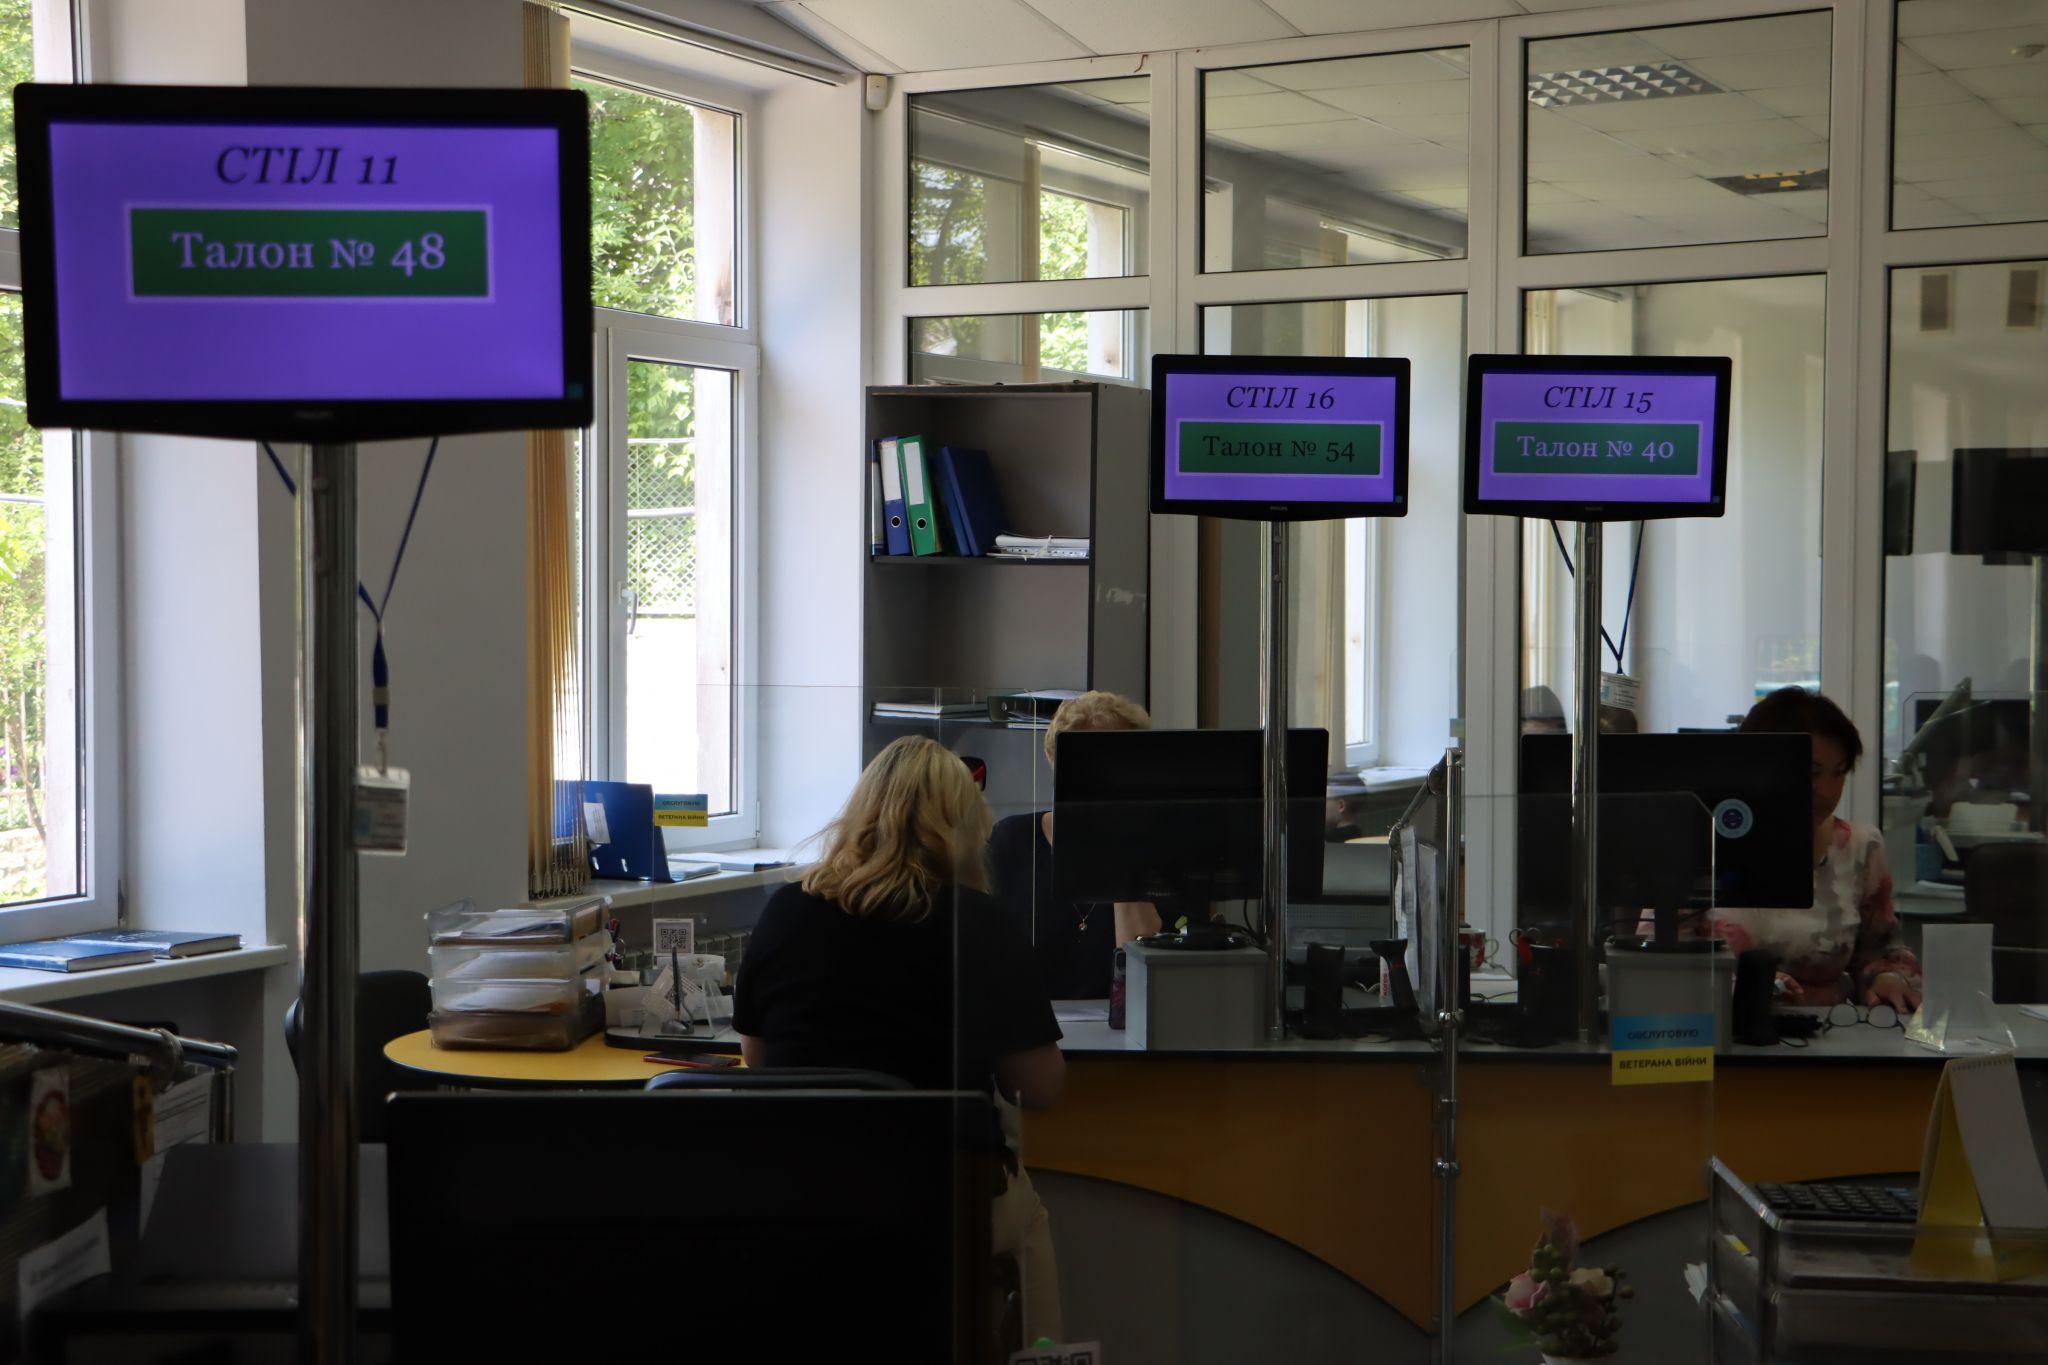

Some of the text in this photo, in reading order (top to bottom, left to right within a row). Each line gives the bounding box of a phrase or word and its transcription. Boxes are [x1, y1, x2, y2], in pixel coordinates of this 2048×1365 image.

[216, 145, 399, 185] СТІЛ 11
[172, 231, 446, 278] Талон № 48
[1226, 386, 1336, 410] СТІЛ 16
[1543, 385, 1654, 414] СТІЛ 15
[1202, 435, 1356, 463] Талон № 54
[1516, 435, 1675, 463] Талон № 40
[1628, 1029, 1698, 1040] ОБСЛУГОВУЮ
[1619, 1056, 1706, 1069] ВЕТЕРАНА ВІЙНИ
